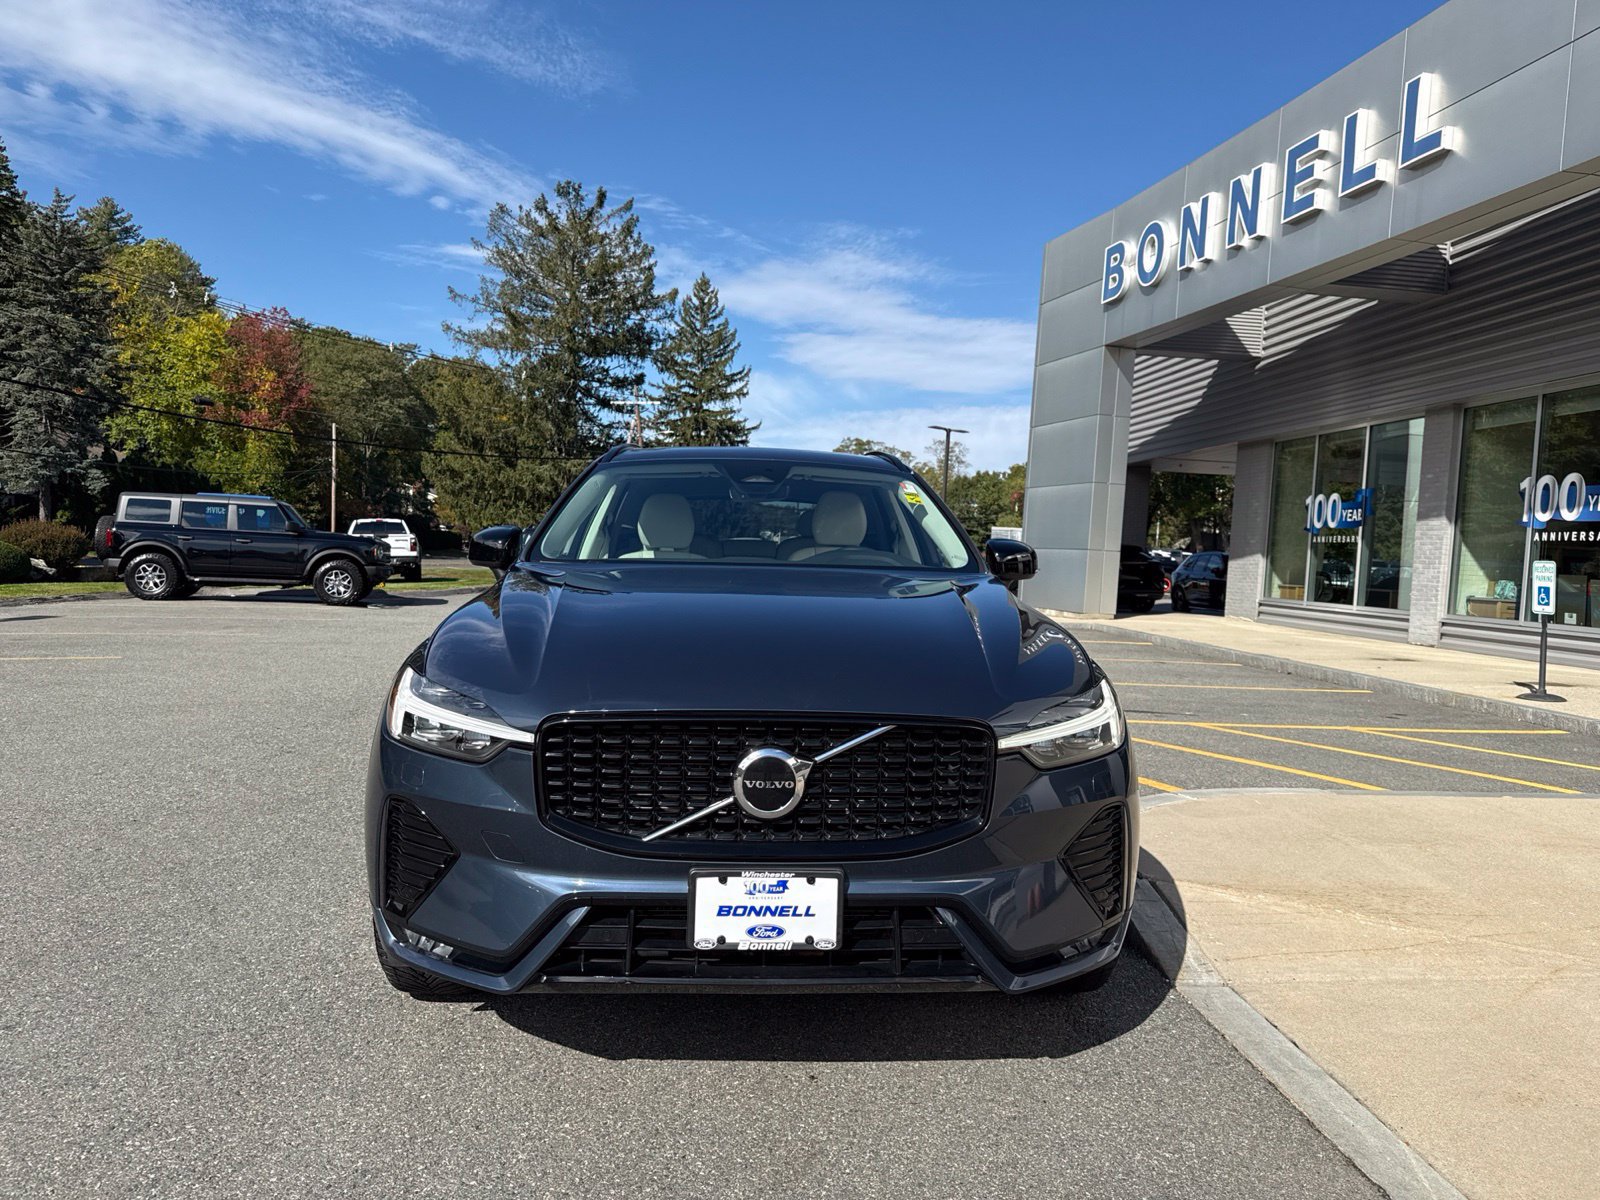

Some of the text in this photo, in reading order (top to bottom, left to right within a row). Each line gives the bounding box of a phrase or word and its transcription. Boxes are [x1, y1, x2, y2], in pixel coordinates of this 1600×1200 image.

[1101, 72, 1456, 305] BONNELL
[1520, 472, 1600, 522] 100 Y
[1305, 492, 1363, 529] 100 YEAR
[744, 780, 794, 788] VOLVO
[744, 881, 769, 894] 100
[716, 905, 816, 917] BONNELL
[753, 926, 779, 938] Ford
[737, 940, 793, 950] Bonnell
